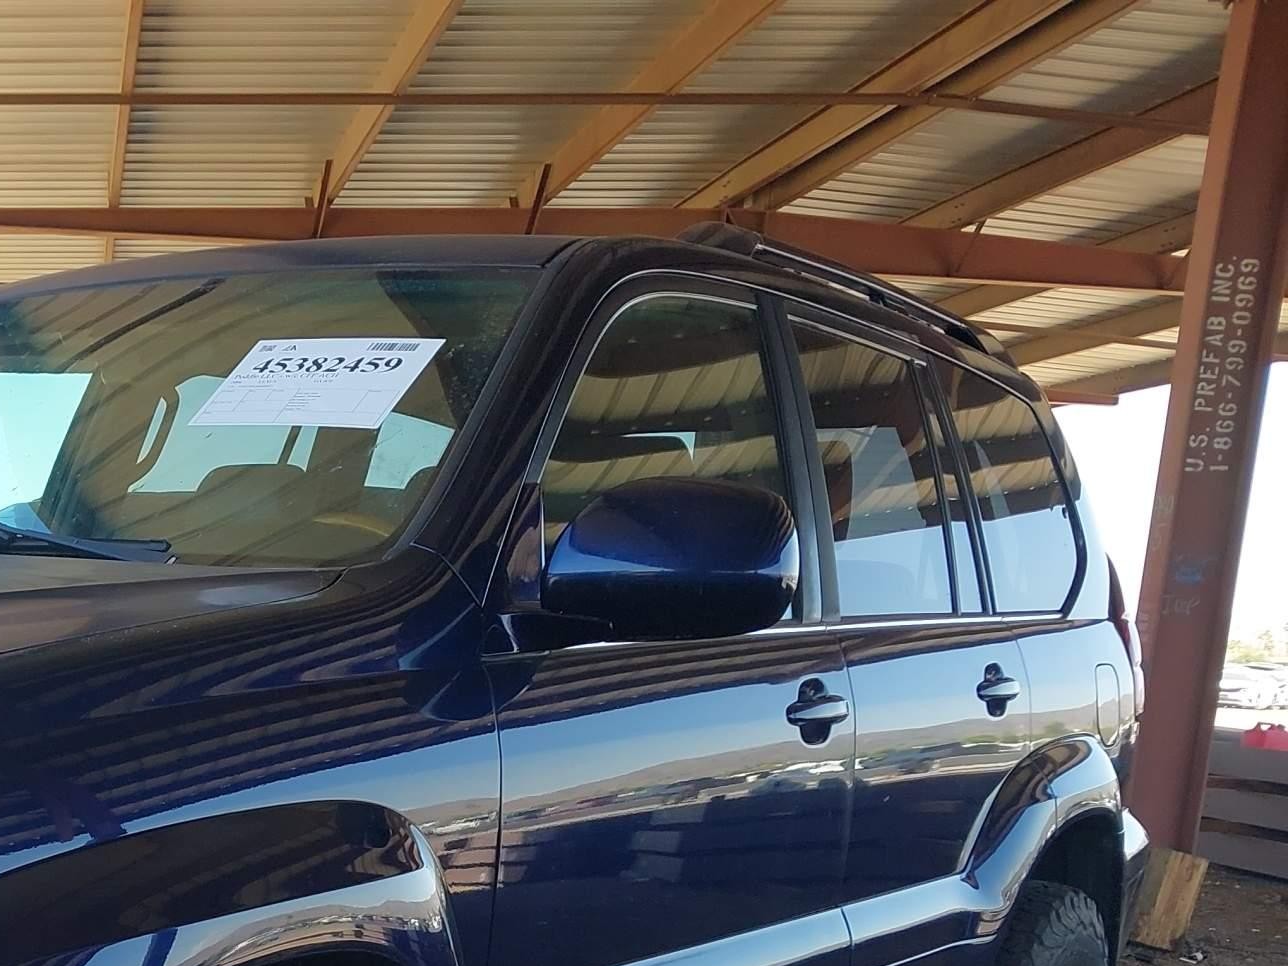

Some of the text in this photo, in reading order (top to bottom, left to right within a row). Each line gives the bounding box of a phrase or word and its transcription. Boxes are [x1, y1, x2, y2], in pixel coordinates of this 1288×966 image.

[253, 357, 403, 373] 45382459
[1184, 255, 1238, 472] U.S. PREFAB INC.
[1209, 257, 1261, 472] 1-866-799-0969
